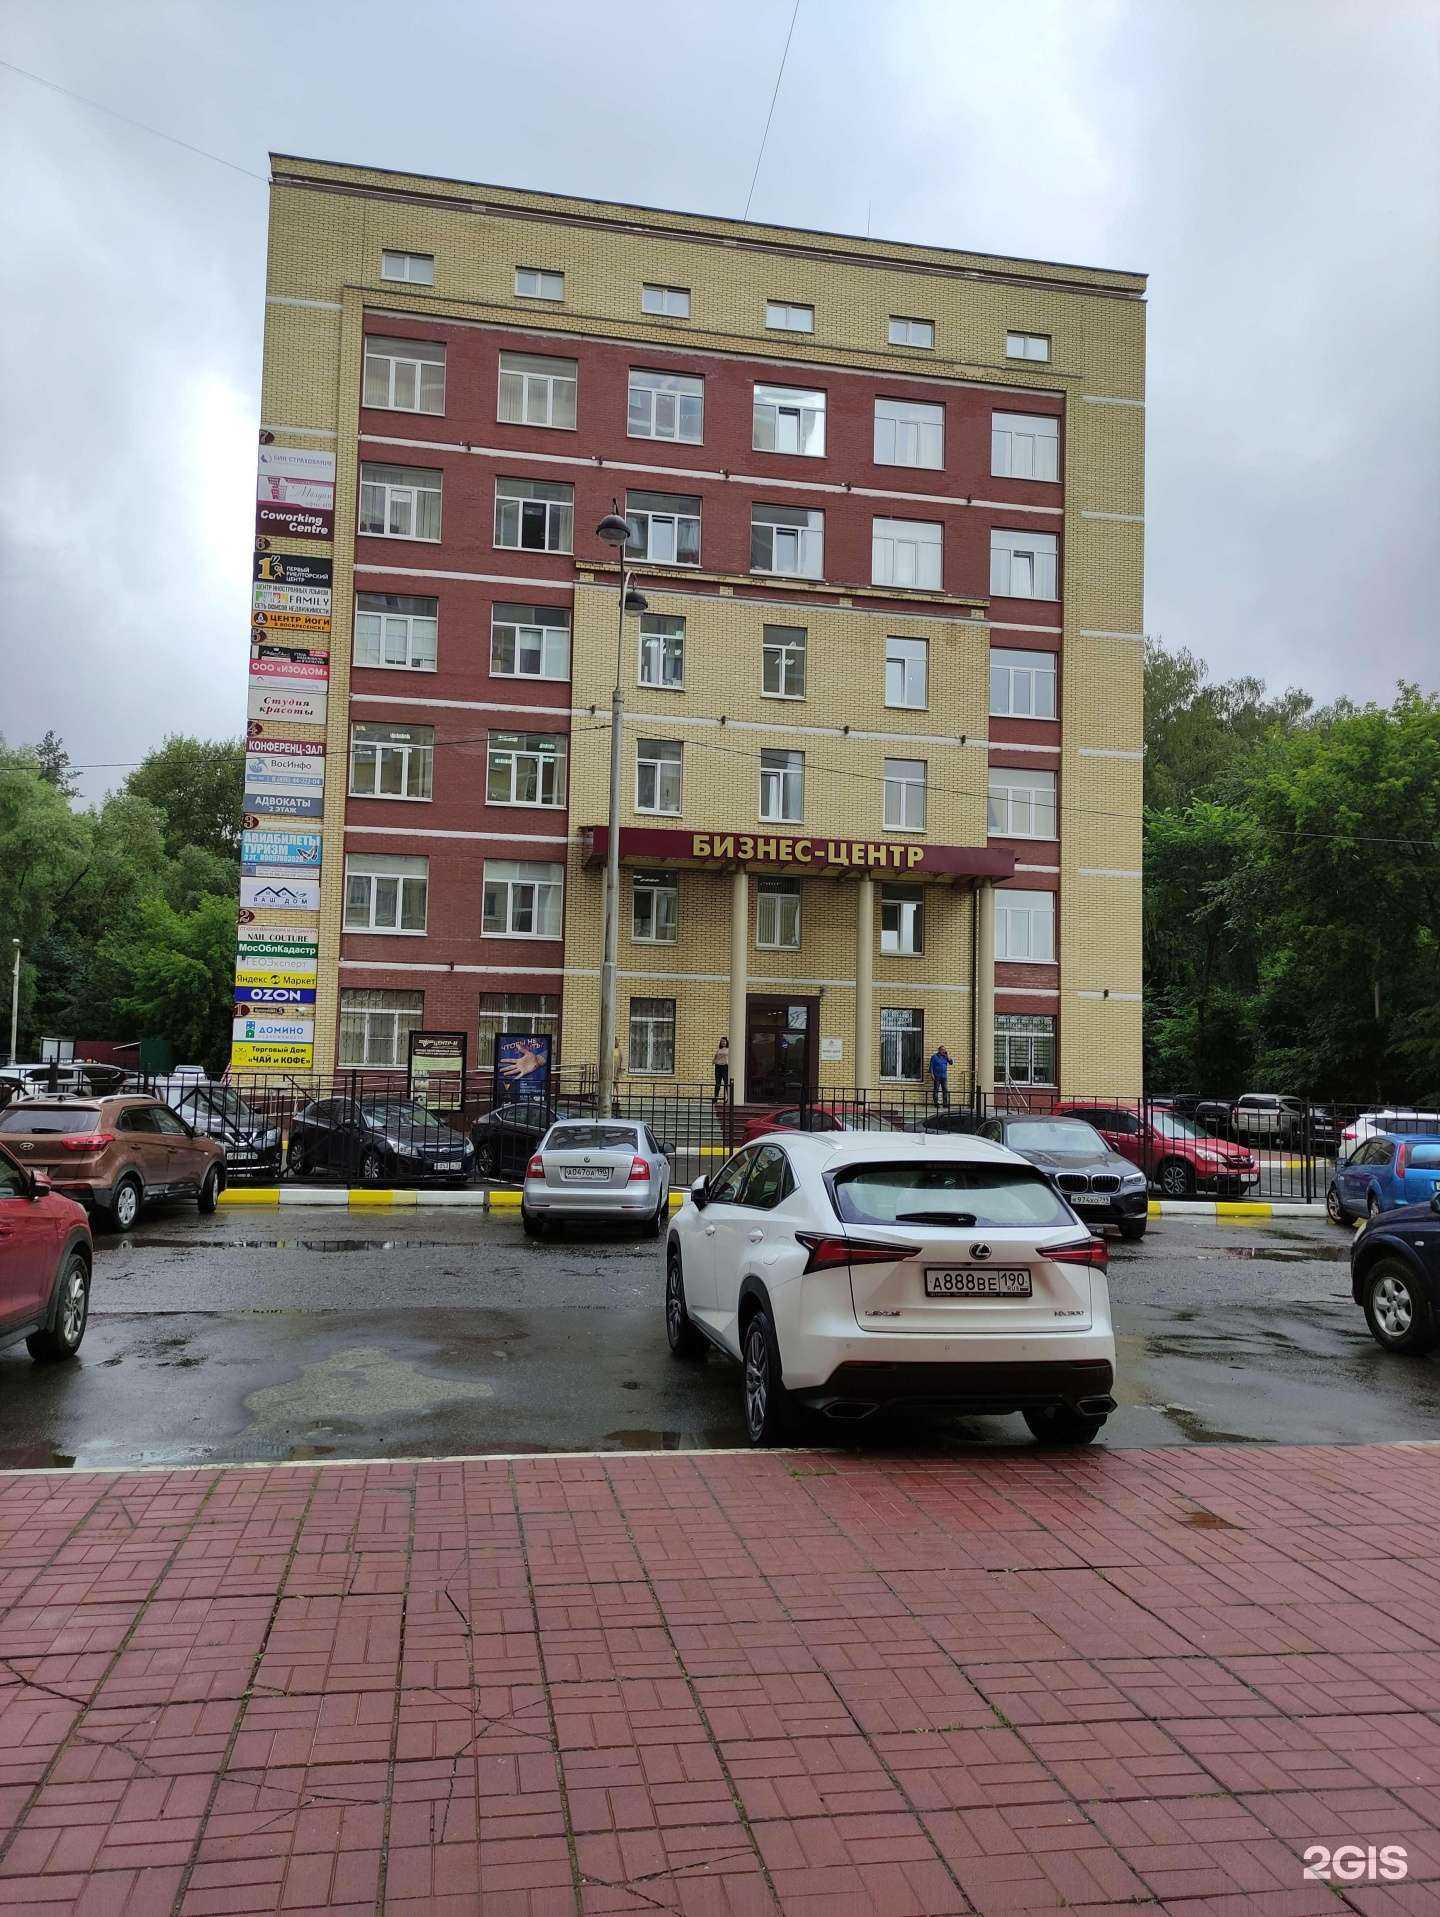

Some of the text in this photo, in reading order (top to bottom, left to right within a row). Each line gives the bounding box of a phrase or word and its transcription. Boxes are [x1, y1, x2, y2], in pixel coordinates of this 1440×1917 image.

[260, 510, 323, 526] Coworking
[289, 523, 329, 535] Centre
[289, 595, 330, 606] FAMILY
[270, 614, 302, 623] ЦЕНТР
[252, 662, 275, 672] ООО
[263, 696, 310, 707] Студия
[259, 706, 314, 716] красоты
[248, 740, 323, 755] КОНФЕРЕНЦ-ЗАЛ
[271, 759, 312, 771] ВосИнфо
[255, 796, 311, 808] АДВОКАТЫ
[243, 832, 321, 847] АВИАБИЛЕТЫ
[243, 843, 288, 855] ТУРИЗМ
[692, 834, 925, 868] БИЗНЕС-ЦЕНТР
[247, 933, 309, 943] NAIL COUTURE
[238, 943, 316, 956] МосОблКадастр
[236, 974, 316, 986] Яндекс Маркет
[250, 988, 301, 1001] OZON
[258, 1026, 304, 1035] ДОМИНО
[252, 1045, 289, 1054] Торговый
[247, 1054, 272, 1064] «ЧАЙ
[280, 1057, 311, 1065] КОФЕ»
[1001, 1273, 1025, 1287] 190
